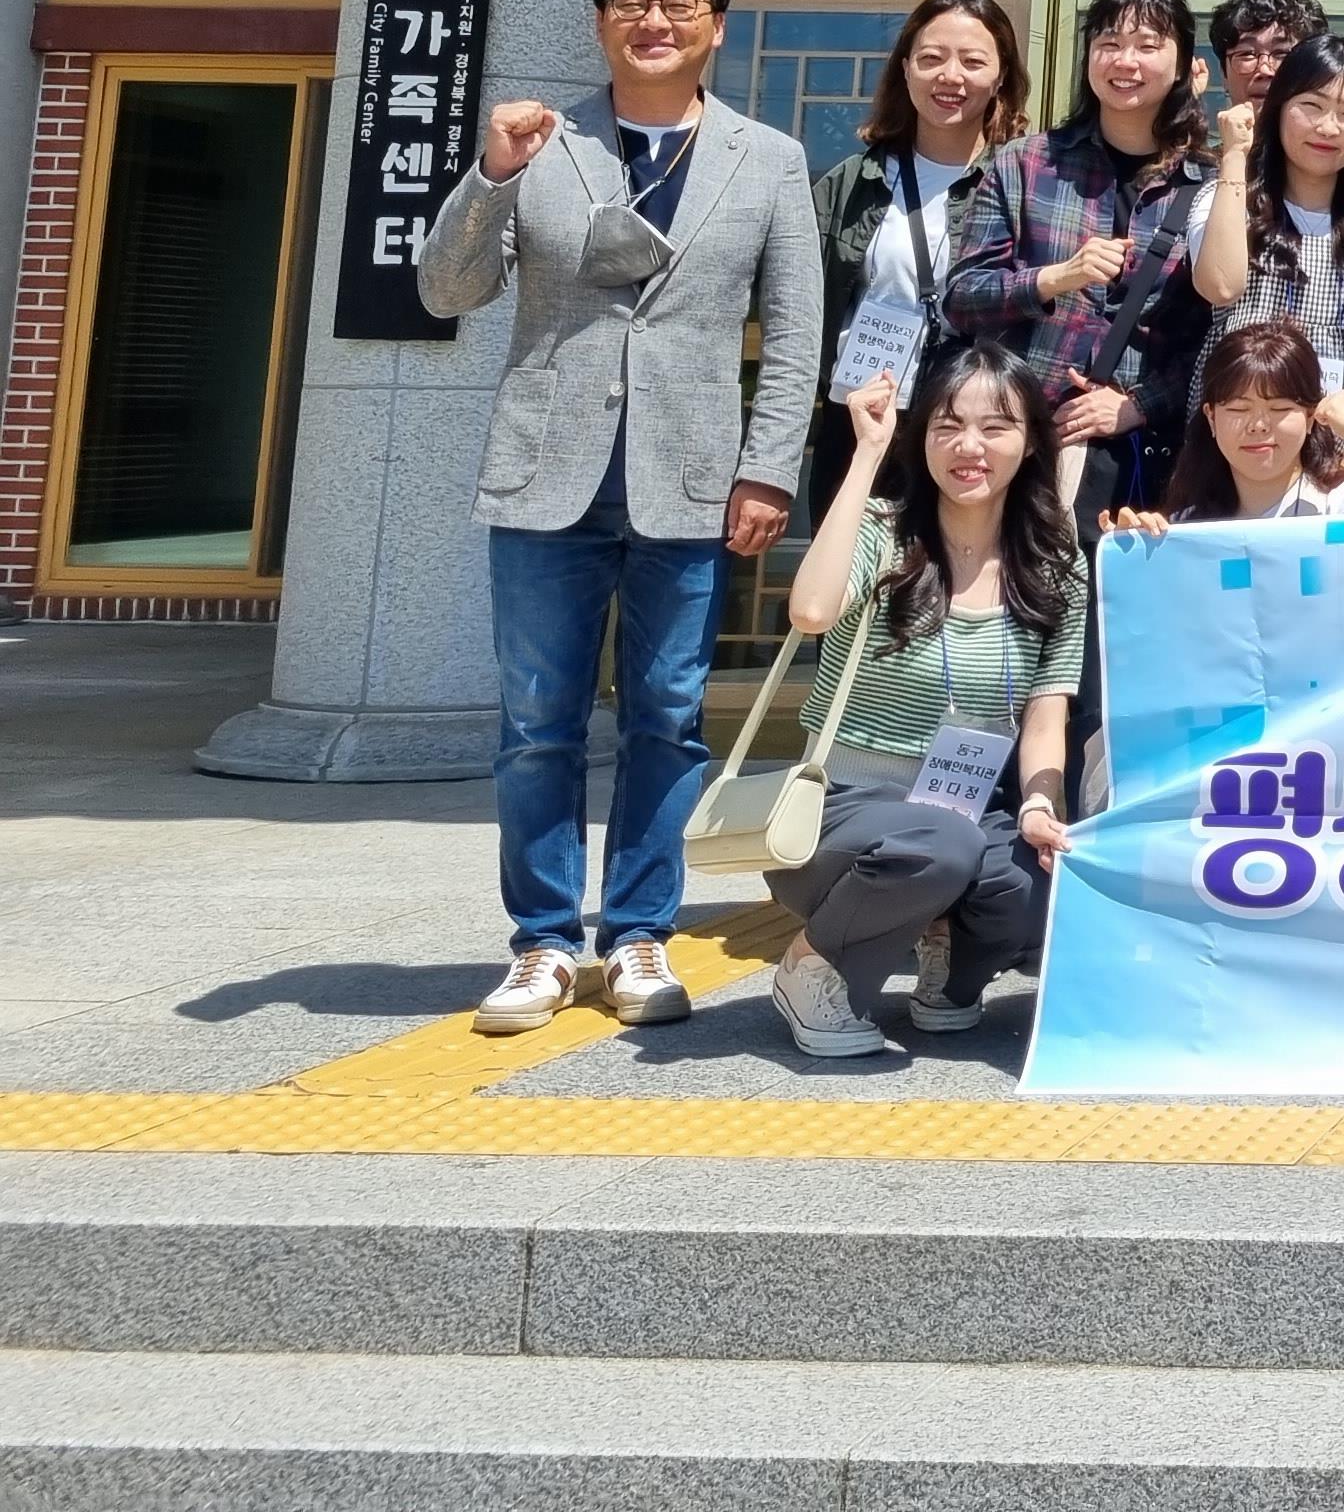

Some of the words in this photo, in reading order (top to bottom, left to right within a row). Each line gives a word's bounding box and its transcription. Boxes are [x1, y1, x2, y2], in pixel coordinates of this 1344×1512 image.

[370, 2, 388, 32] City
[365, 37, 384, 87] Family
[449, 53, 468, 117] 경상북도
[360, 91, 378, 144] Center
[444, 125, 462, 173] 경주시
[928, 756, 997, 780] 장애인복지관
[956, 743, 985, 758] 동구
